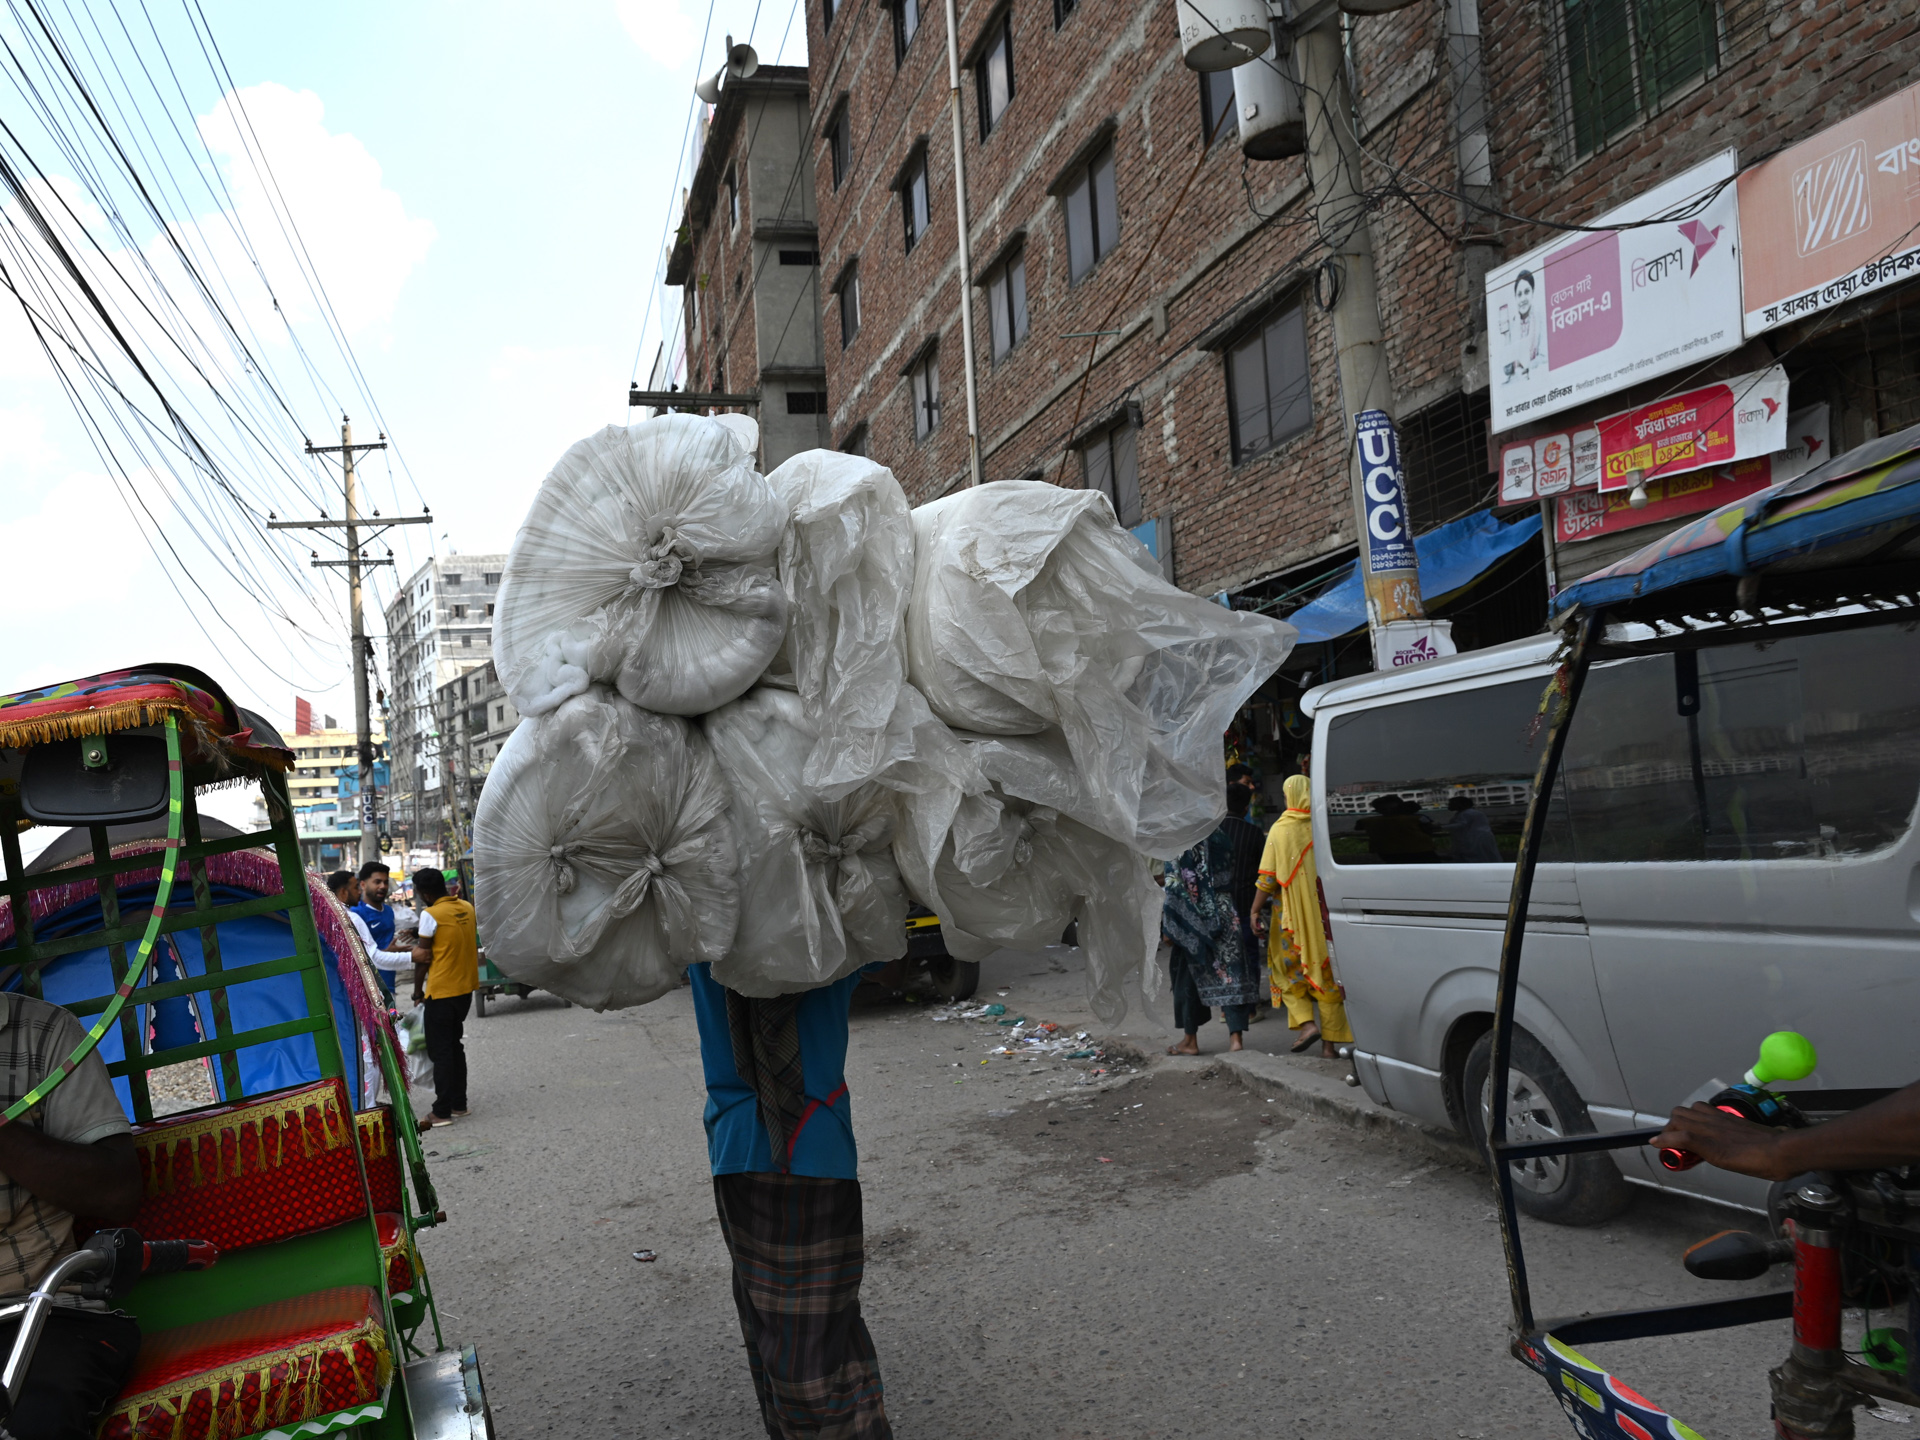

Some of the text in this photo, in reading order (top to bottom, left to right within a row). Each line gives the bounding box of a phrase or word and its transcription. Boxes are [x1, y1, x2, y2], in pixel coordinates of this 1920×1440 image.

[1631, 247, 1684, 292] বিকাশ
[1822, 274, 1858, 303] দোয়া
[1861, 248, 1920, 286] টেলিক
[1550, 275, 1592, 307] বেতন পাই
[1551, 291, 1612, 333] বিকাশ-এ
[1547, 384, 1573, 402] টেলিকম
[1634, 408, 1697, 440] সুবিধা ডাবল
[1737, 408, 1764, 424] বিকাশ
[1358, 428, 1402, 541] UCC
[1540, 467, 1567, 486] নগদ
[1563, 510, 1604, 534] ডাবল
[362, 795, 373, 824] UCC
